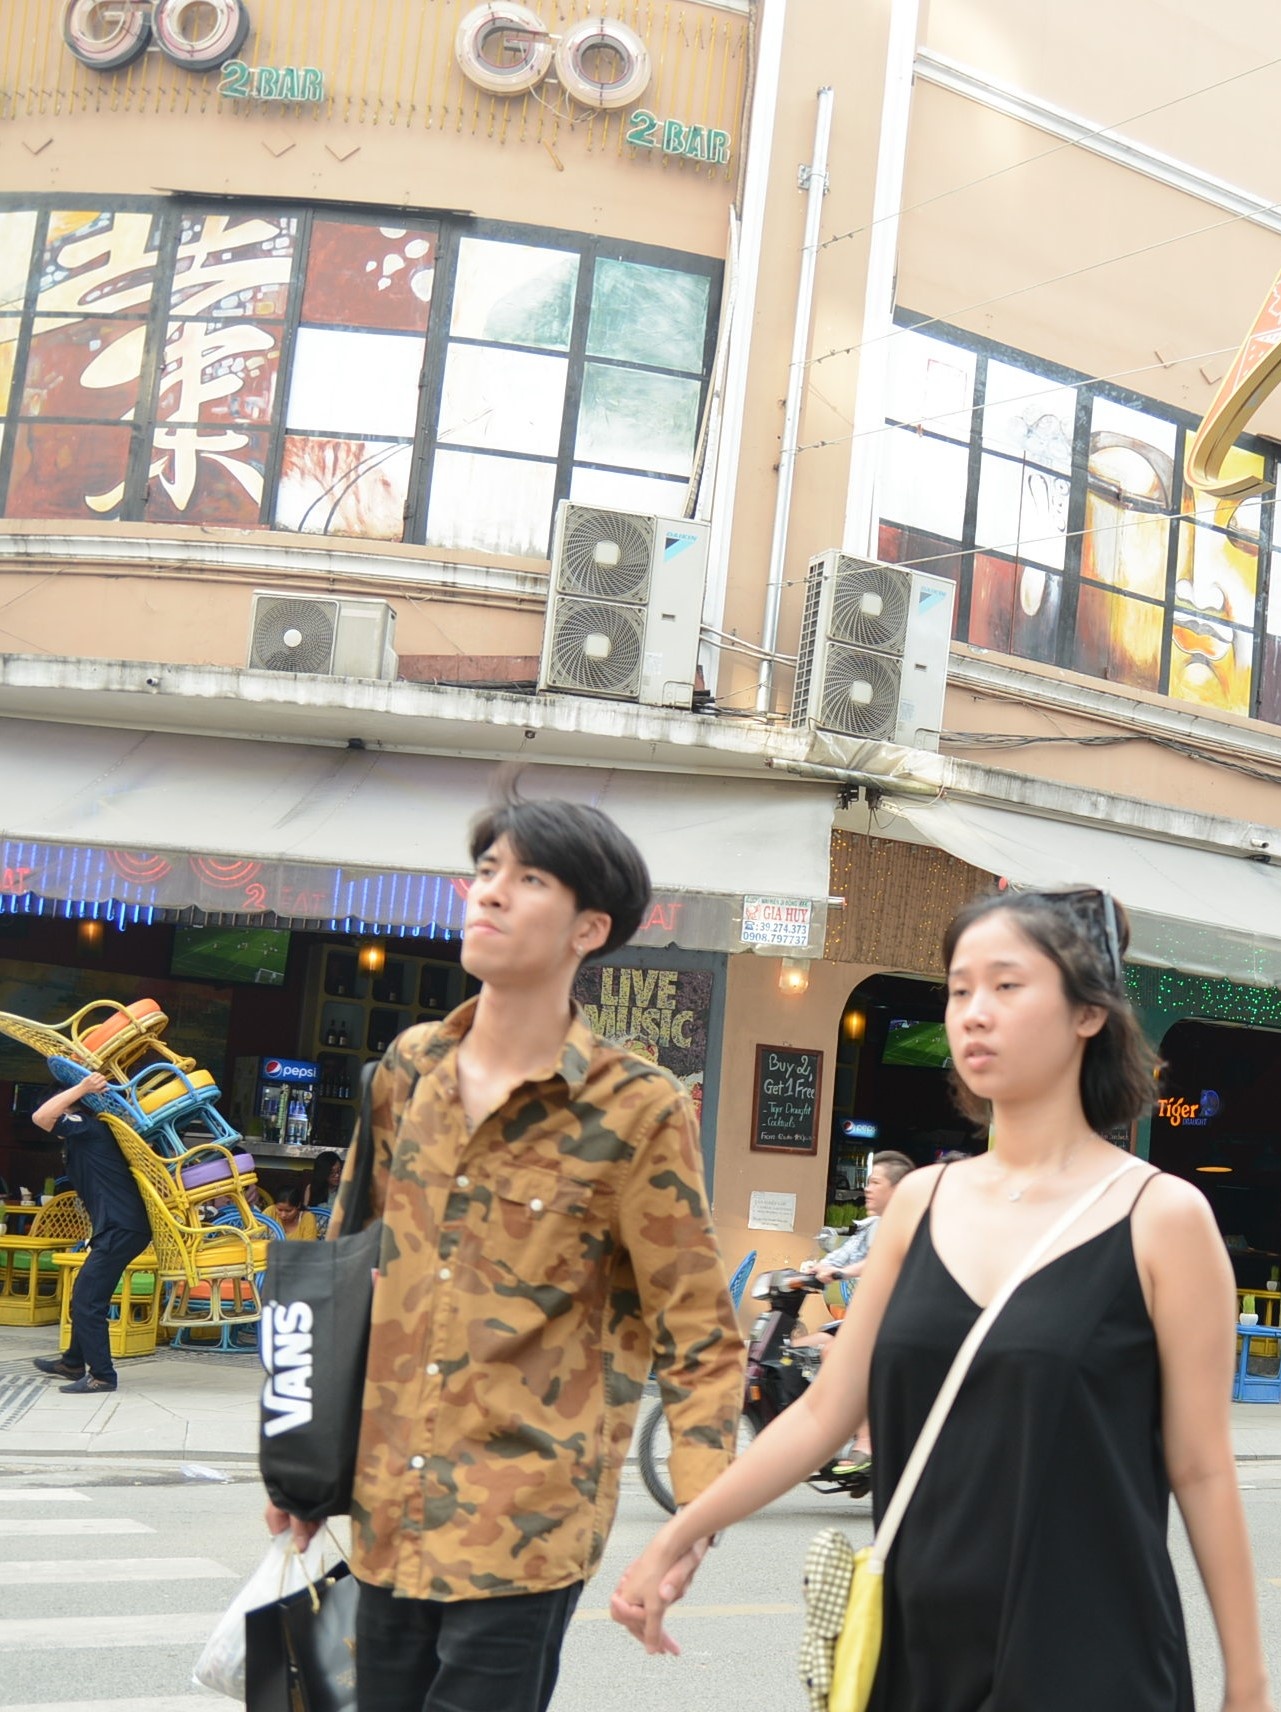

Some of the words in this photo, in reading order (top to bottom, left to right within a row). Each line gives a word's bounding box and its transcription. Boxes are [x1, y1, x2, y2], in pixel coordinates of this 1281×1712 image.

[454, 0, 652, 112] GO
[216, 59, 248, 98] 2
[256, 66, 325, 102] BAR
[627, 109, 657, 148] 2
[662, 119, 731, 164] BAR
[763, 905, 782, 921] GIA
[785, 907, 809, 923] HUY
[601, 967, 679, 1010] LIVE
[584, 1004, 694, 1048] MUSIC
[283, 1065, 316, 1079] pepsi
[768, 1053, 795, 1079] Buy
[763, 1079, 784, 1095] Get
[784, 1077, 794, 1097] 1
[795, 1079, 815, 1099] Free
[1157, 1097, 1199, 1126] Tiger
[1182, 1118, 1207, 1126] DRAUGHT
[262, 1301, 313, 1437] VANS
